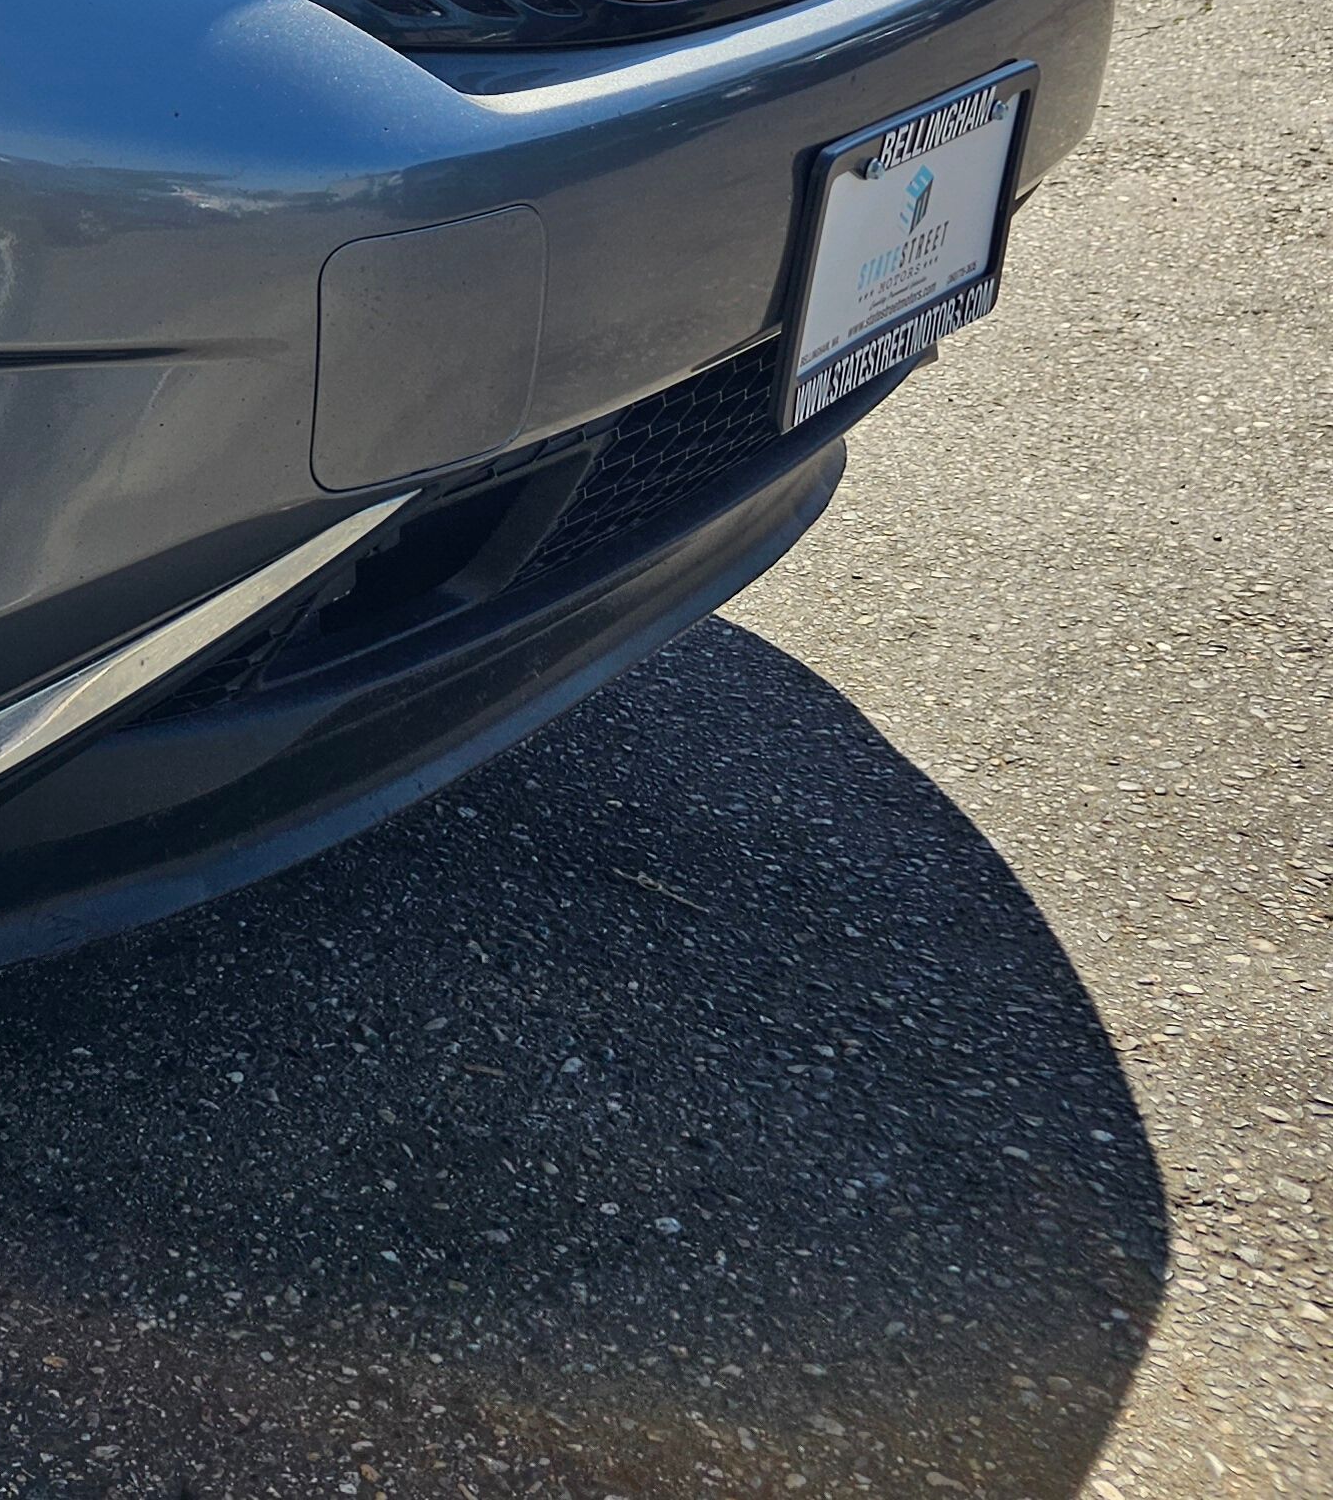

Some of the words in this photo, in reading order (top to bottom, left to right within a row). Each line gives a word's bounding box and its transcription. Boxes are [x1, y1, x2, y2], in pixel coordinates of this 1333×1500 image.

[879, 86, 998, 170] BELLINGHAM
[878, 263, 921, 294] MOTORS
[792, 278, 996, 428] WWW.STATESTREETMOTORS.COM
